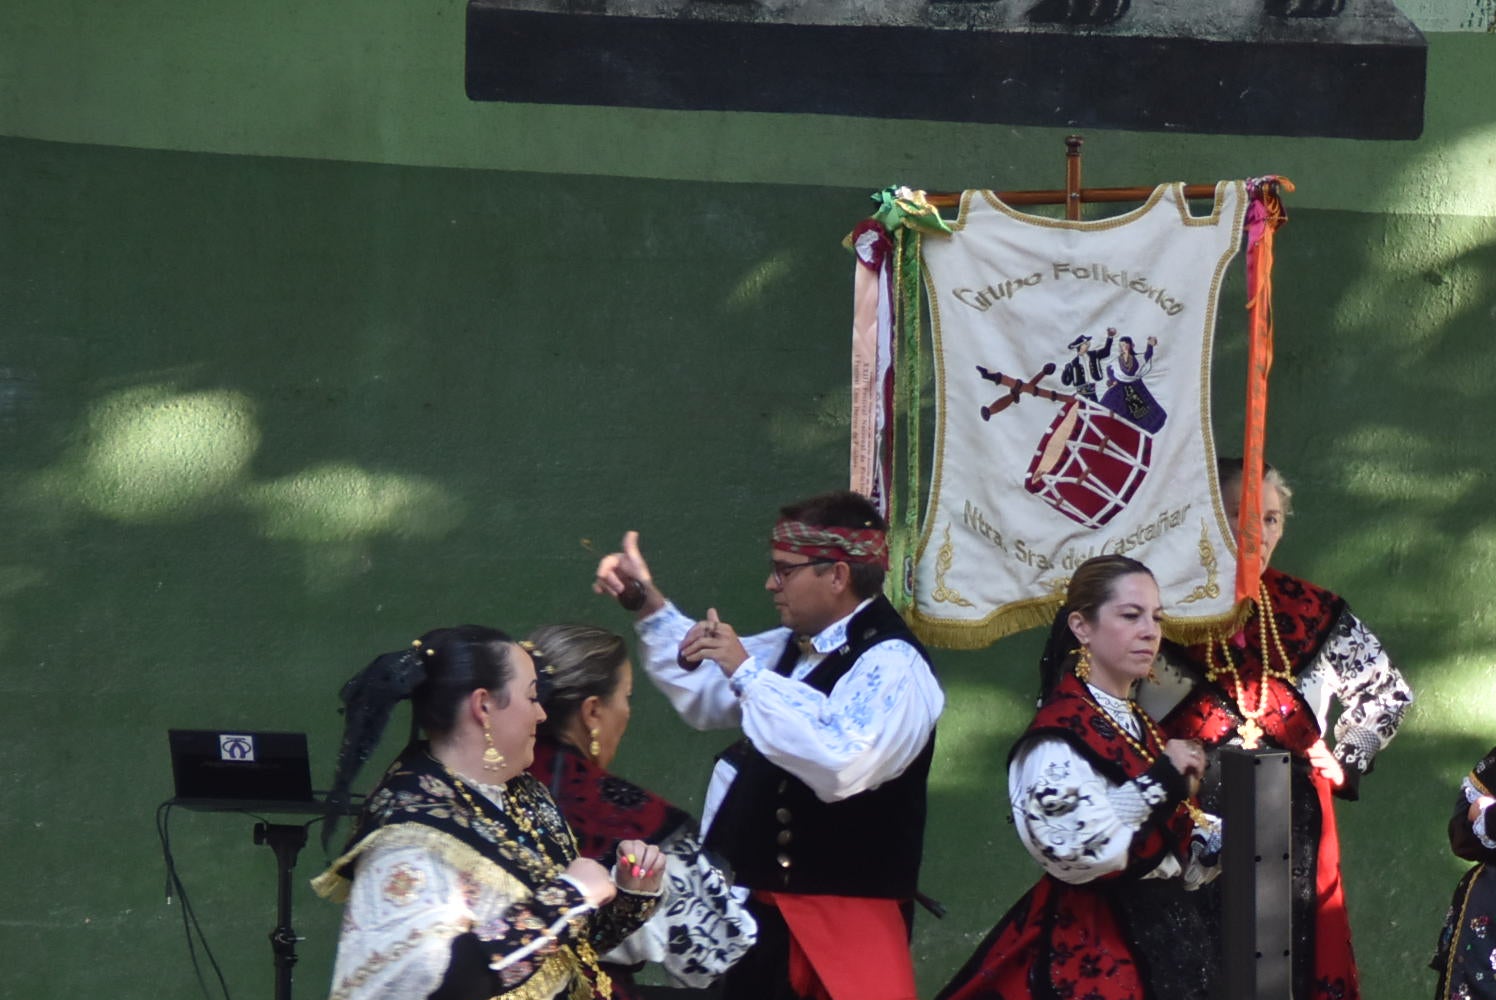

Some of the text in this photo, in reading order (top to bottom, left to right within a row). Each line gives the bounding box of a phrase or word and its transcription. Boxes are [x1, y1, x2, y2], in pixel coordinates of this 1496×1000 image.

[952, 263, 1185, 316] Grupo Folklórico
[1014, 539, 1055, 571] Sra.
[1101, 503, 1191, 556] Castañar
